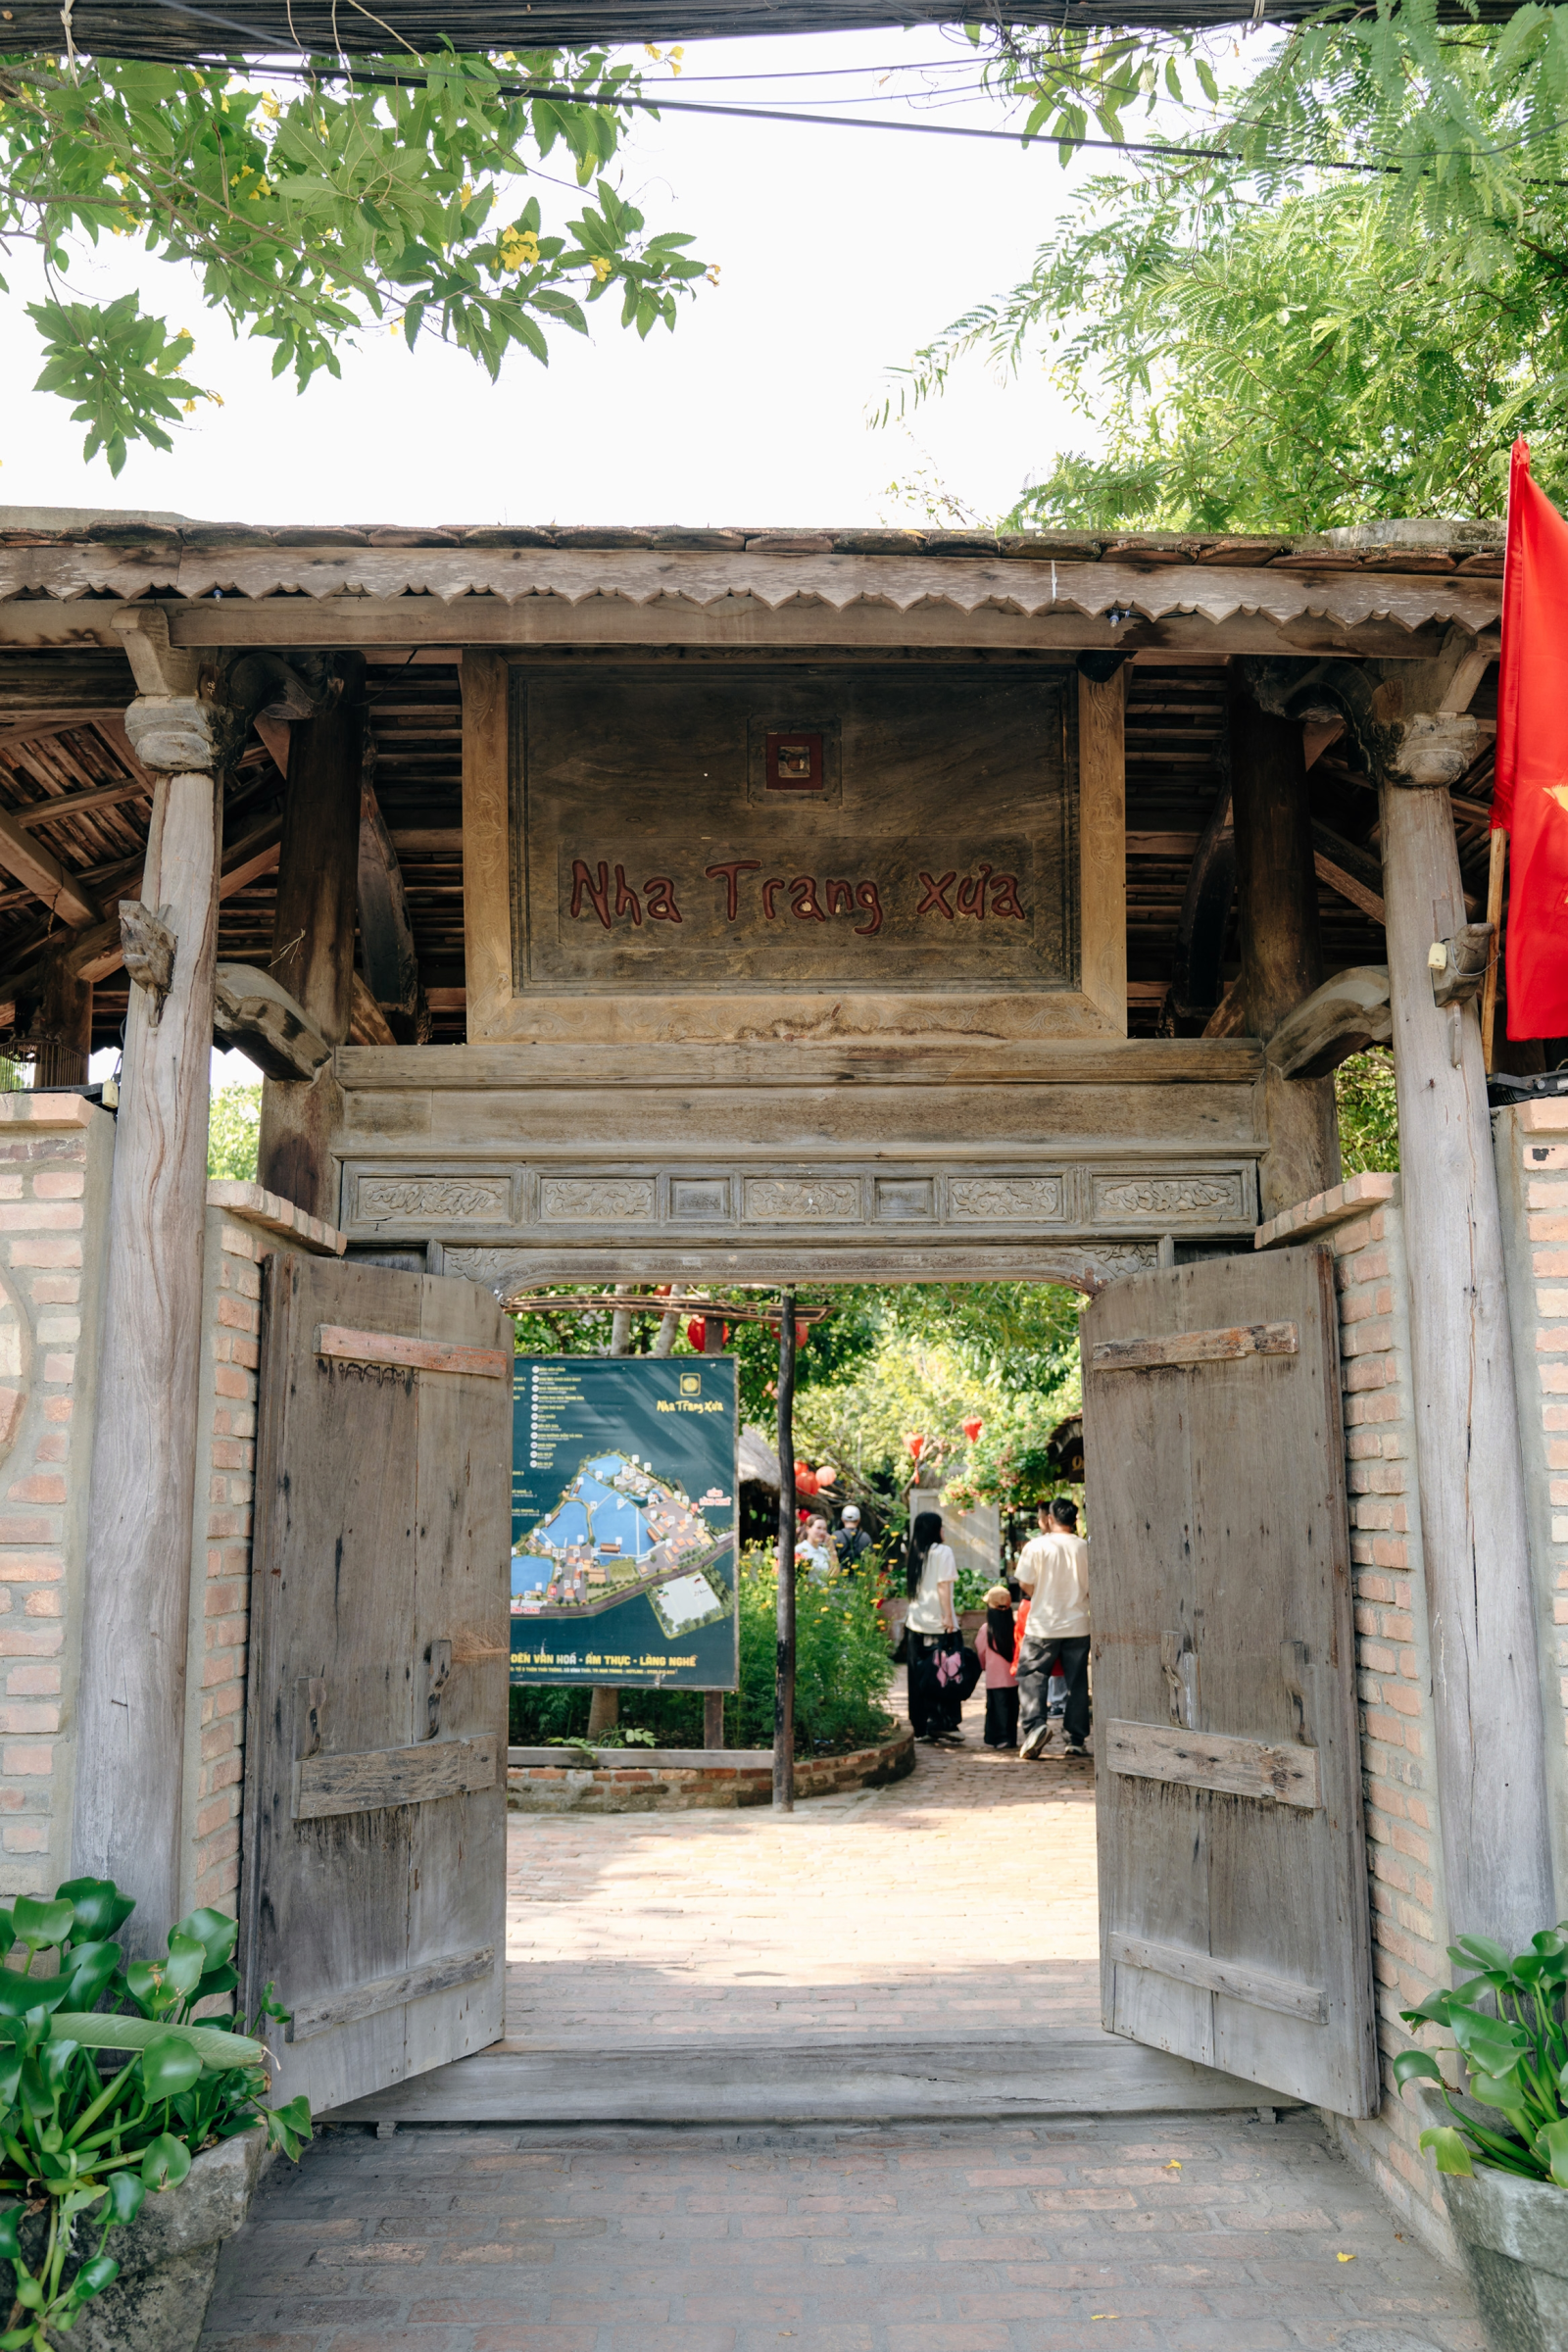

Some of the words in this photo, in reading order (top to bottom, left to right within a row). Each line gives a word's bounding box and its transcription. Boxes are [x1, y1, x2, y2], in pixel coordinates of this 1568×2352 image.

[569, 858, 683, 930] Nha
[705, 858, 883, 936] Trang
[657, 1399, 676, 1413] Nha
[675, 1399, 704, 1414] Trang
[639, 1653, 666, 1667] LÀNG
